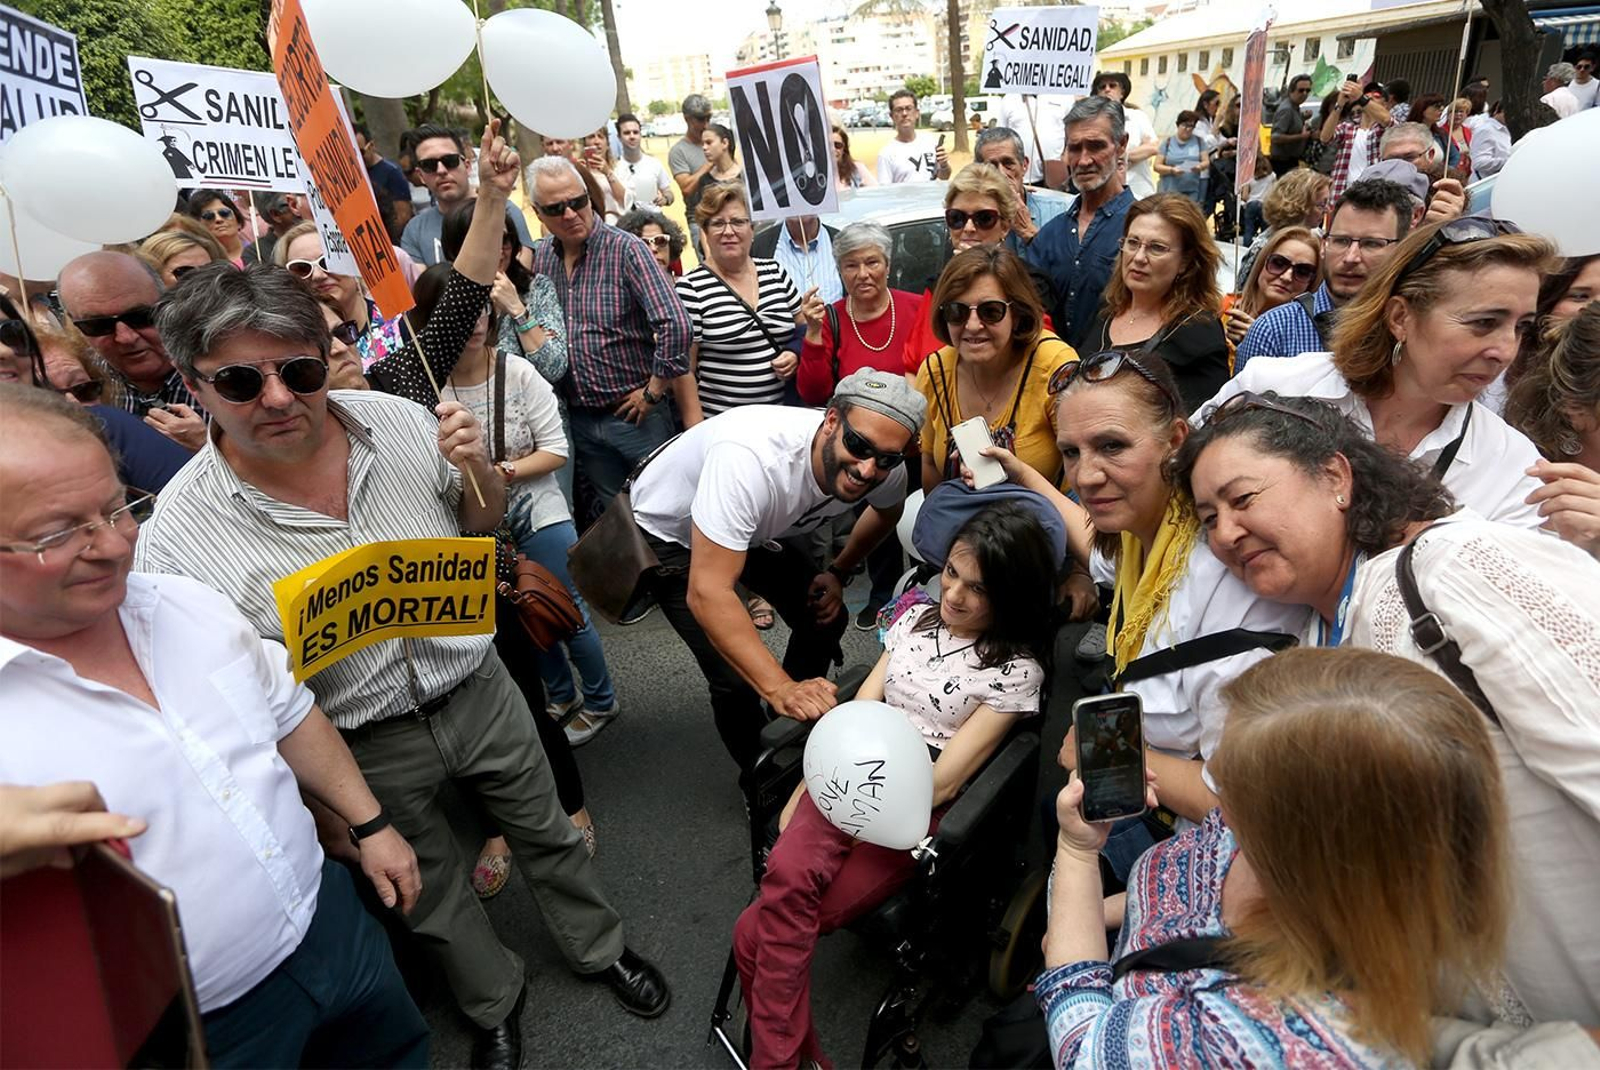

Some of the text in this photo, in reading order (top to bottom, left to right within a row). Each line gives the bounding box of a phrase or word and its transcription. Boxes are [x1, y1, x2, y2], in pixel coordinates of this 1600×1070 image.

[1019, 26, 1094, 56] SANIDAD,
[1004, 62, 1091, 88] CRIMEN LEGAL!
[192, 140, 301, 179] CRIMEN LE
[730, 73, 828, 212] NO
[298, 552, 489, 637] ¡Menos Sanidad
[301, 594, 489, 666] ES MORTAL!
